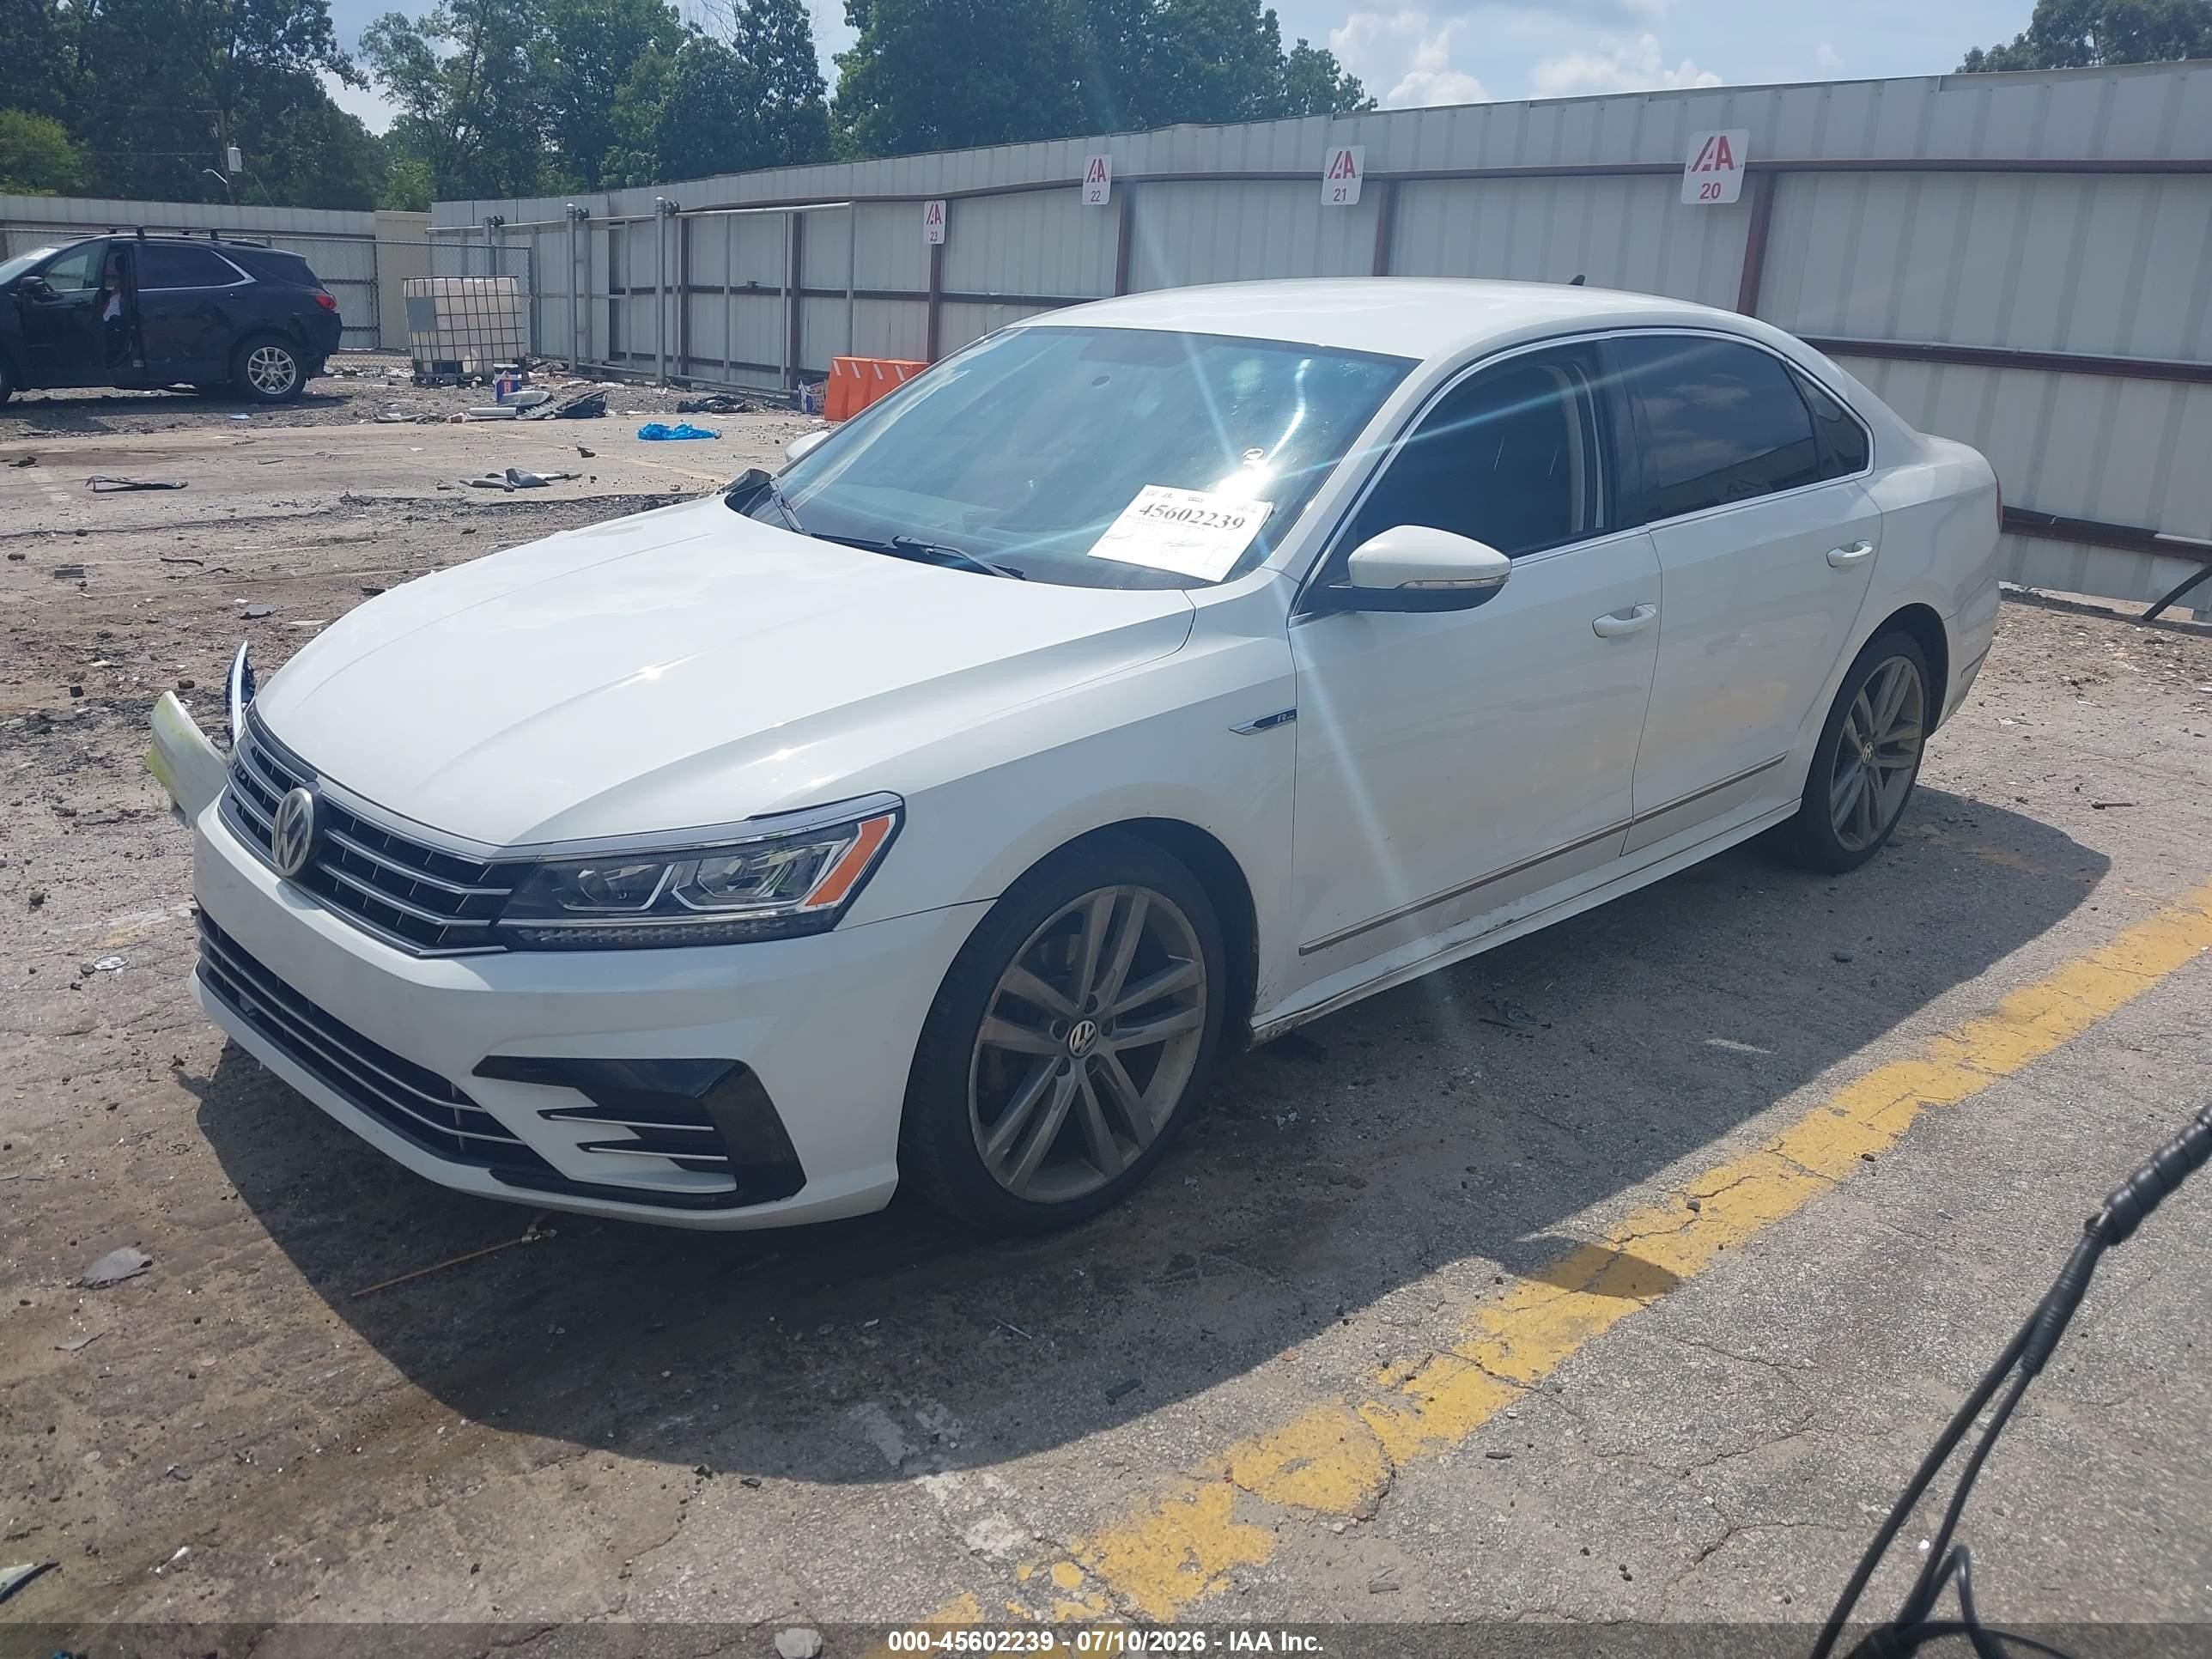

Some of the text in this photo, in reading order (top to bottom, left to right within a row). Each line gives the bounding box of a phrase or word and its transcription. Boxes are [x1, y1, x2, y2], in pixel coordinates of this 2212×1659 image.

[1091, 191, 1100, 202] 22
[1334, 187, 1346, 202] 21
[1699, 182, 1721, 199] 20
[1139, 502, 1245, 531] 45602239
